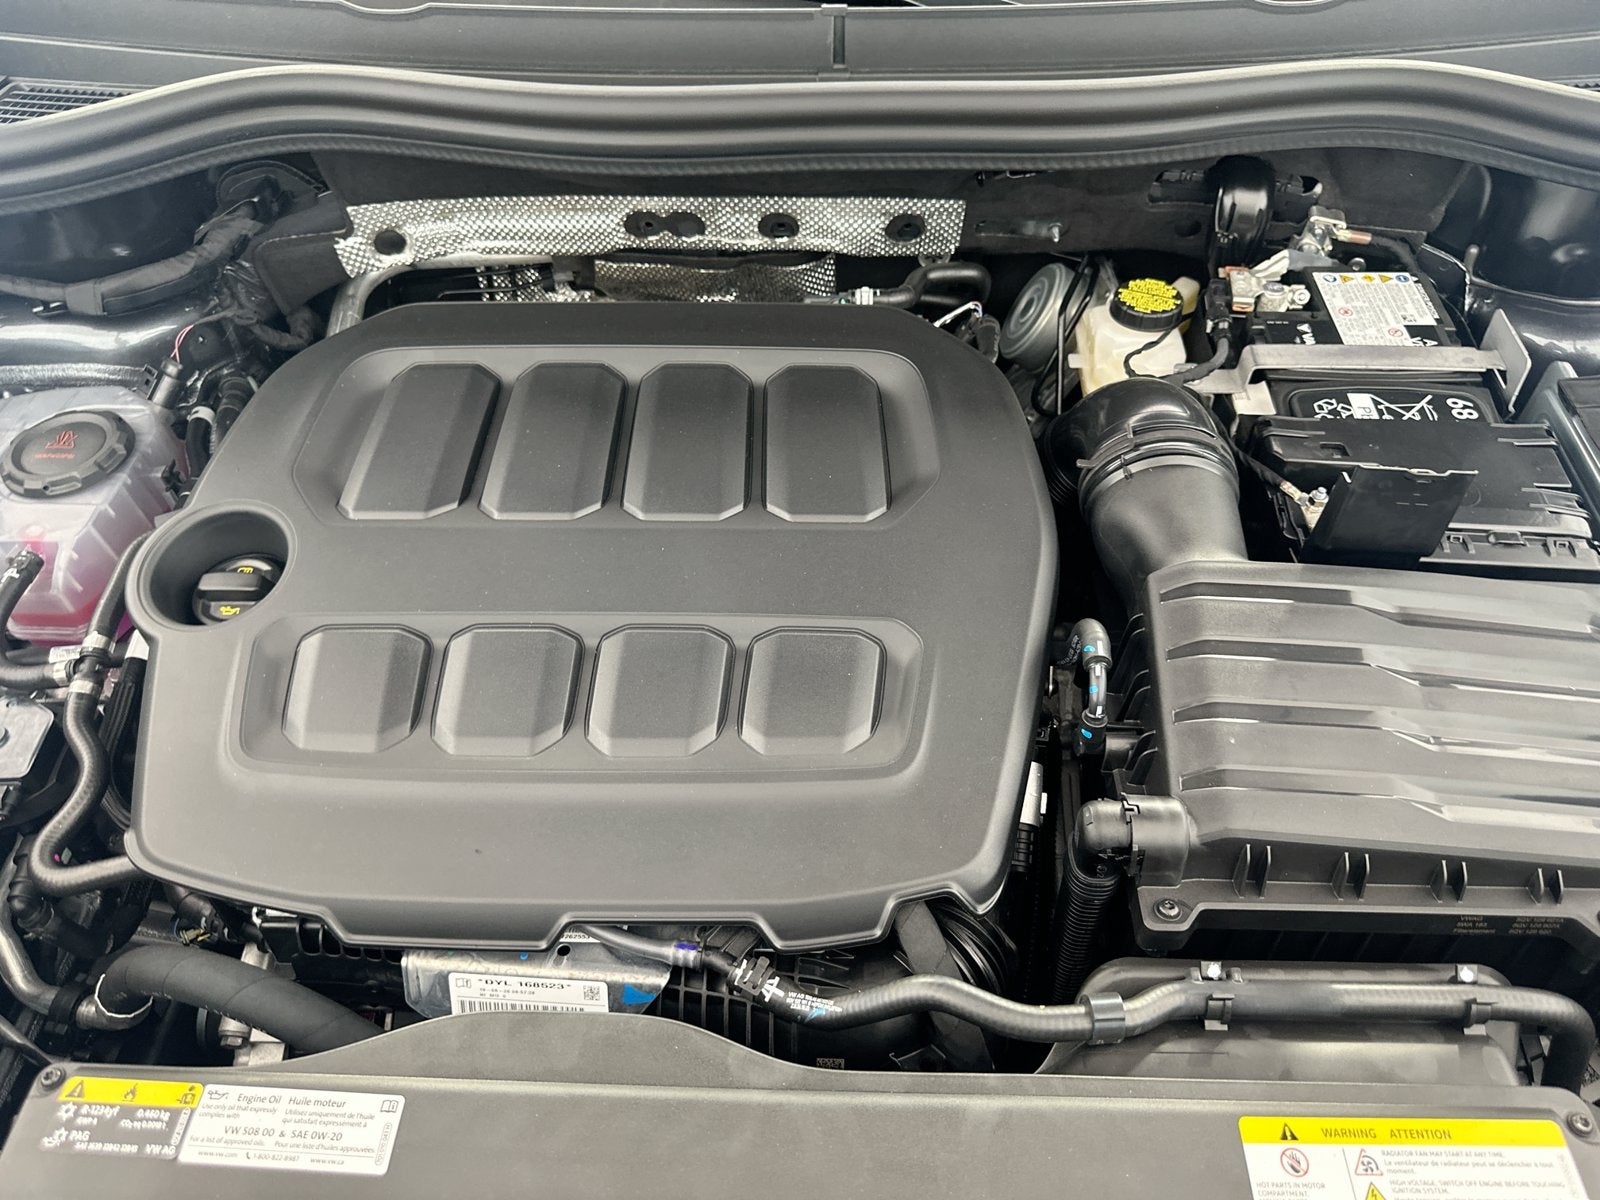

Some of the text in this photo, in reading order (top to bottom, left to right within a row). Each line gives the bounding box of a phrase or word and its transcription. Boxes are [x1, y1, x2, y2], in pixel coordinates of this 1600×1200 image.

[237, 1093, 347, 1108] Engine Oil Huile moteur
[213, 1103, 227, 1111] only
[249, 1106, 278, 1114] expressly
[308, 1110, 347, 1119] uniquement
[347, 1112, 356, 1120] de
[68, 1129, 91, 1141] PAG
[224, 1125, 343, 1141] VW 508 00 & SAE 0W-20
[1320, 1127, 1452, 1141] WARNING ATTENTION
[144, 1142, 176, 1155] VW AG
[1271, 1182, 1292, 1190] PARTS
[1302, 1182, 1326, 1190] MOTOR
